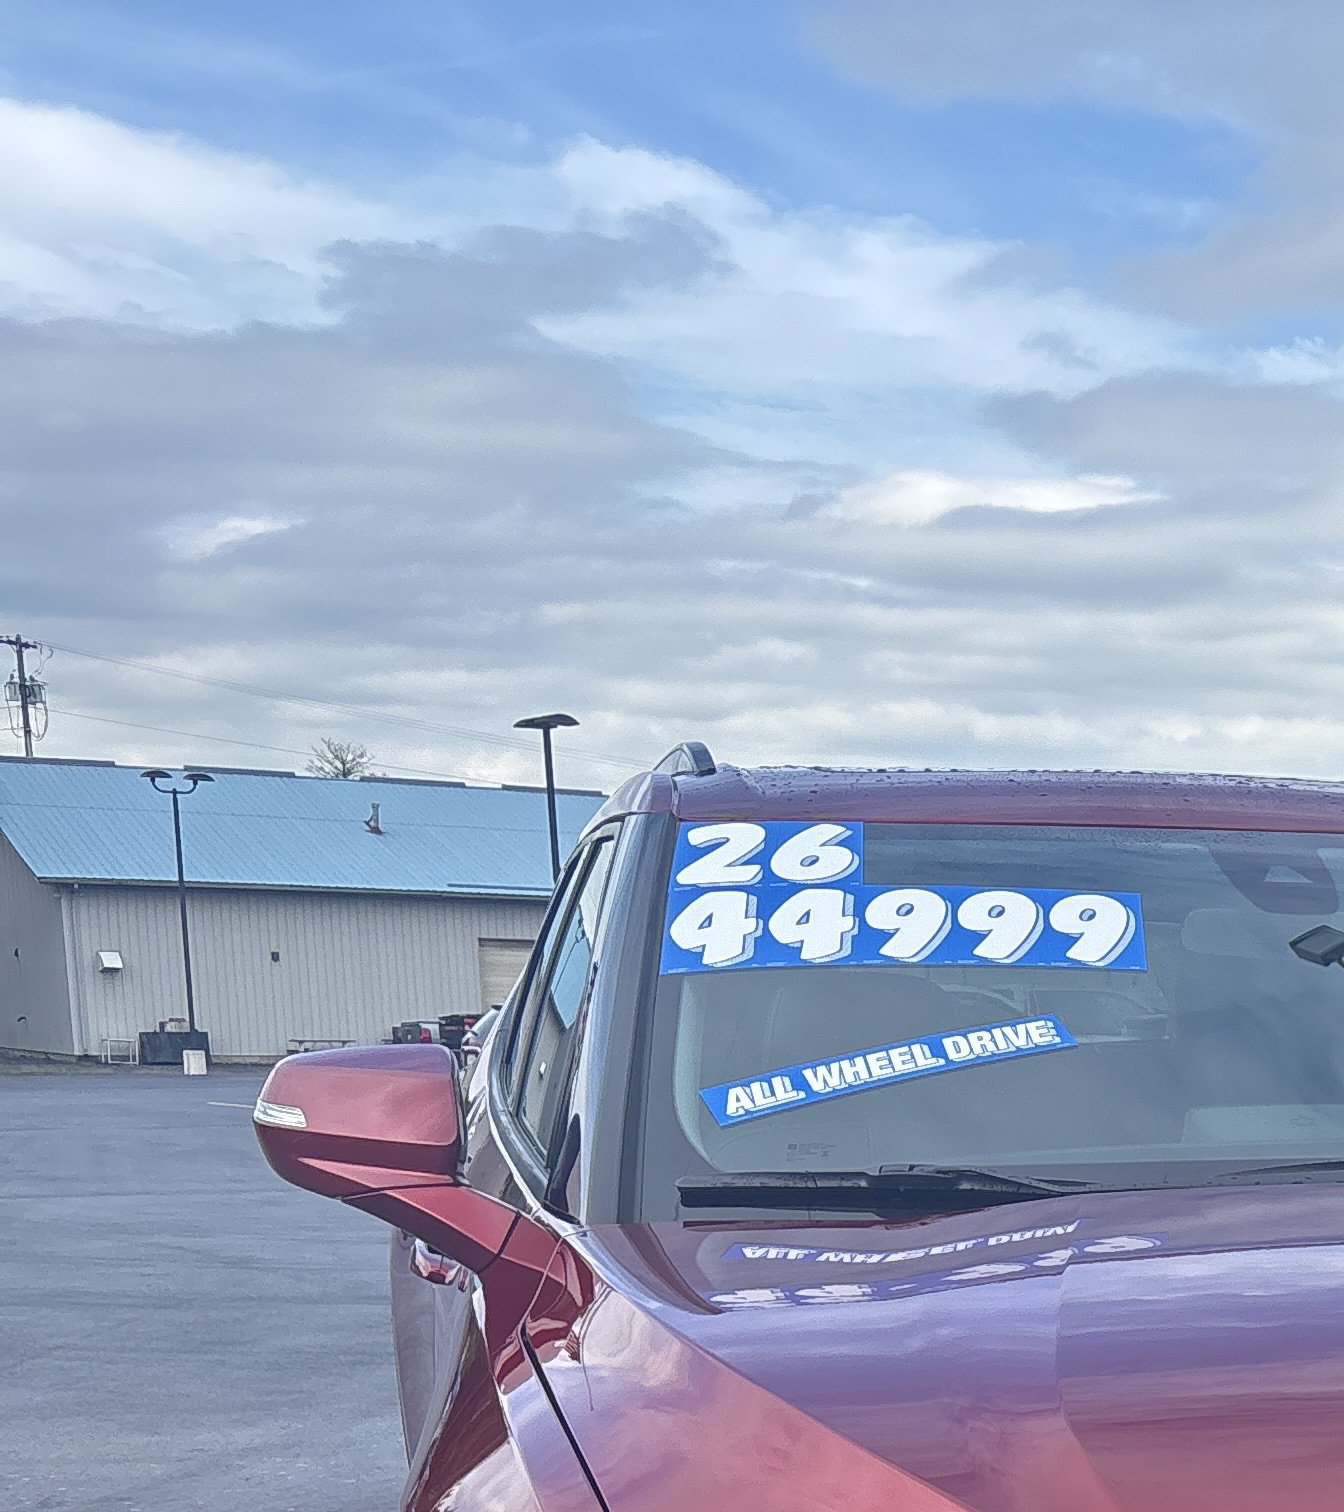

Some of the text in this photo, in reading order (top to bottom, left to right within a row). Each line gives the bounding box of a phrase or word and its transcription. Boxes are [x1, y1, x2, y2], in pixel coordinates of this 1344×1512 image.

[675, 822, 860, 887] 26
[669, 888, 1138, 968] 44999
[724, 1018, 1062, 1118] ALL WHEEL DRIVE
